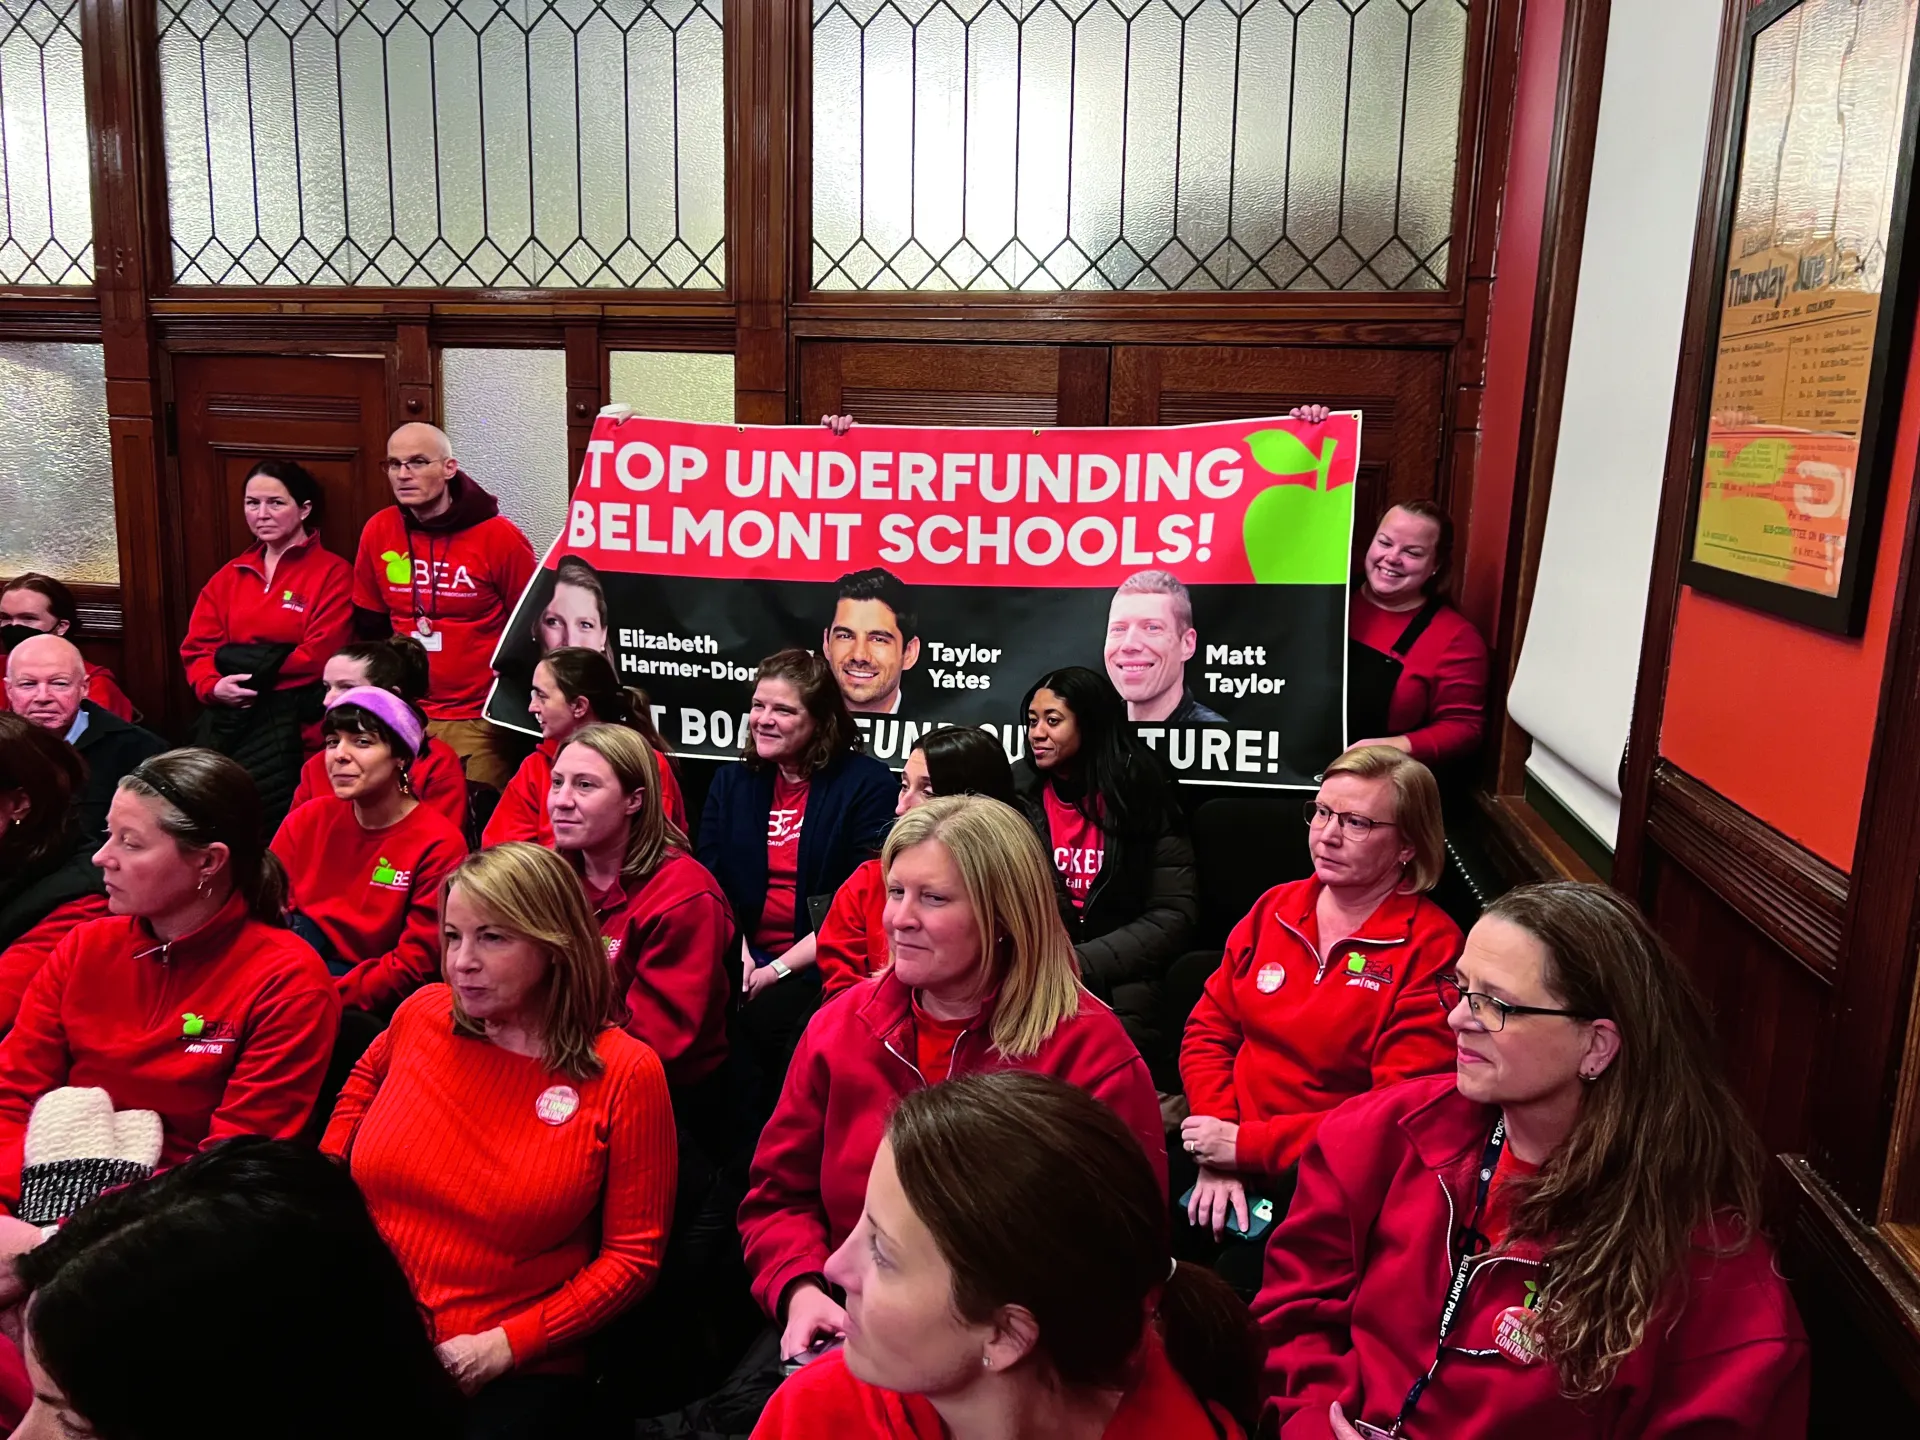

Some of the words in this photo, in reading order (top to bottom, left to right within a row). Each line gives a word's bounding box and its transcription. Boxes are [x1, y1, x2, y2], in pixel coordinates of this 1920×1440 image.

[577, 439, 709, 494] TOP
[724, 447, 1245, 504] UNDERFUNDING
[567, 500, 862, 562] BELMONT
[877, 512, 1215, 567] SCHOOLS!
[413, 558, 477, 590] BEA
[619, 628, 719, 655] Elizabeth
[927, 642, 1002, 669] Taylor
[1205, 644, 1267, 667] Matt
[928, 668, 991, 690] Yates
[1204, 673, 1286, 696] Taylor
[850, 717, 956, 760] FUN
[1137, 728, 1279, 774] TURE!
[392, 870, 411, 886] BE
[1491, 1117, 1505, 1146] OOLS
[1450, 1254, 1471, 1302] BELMONT
[1440, 1300, 1456, 1337] PUBLIC
